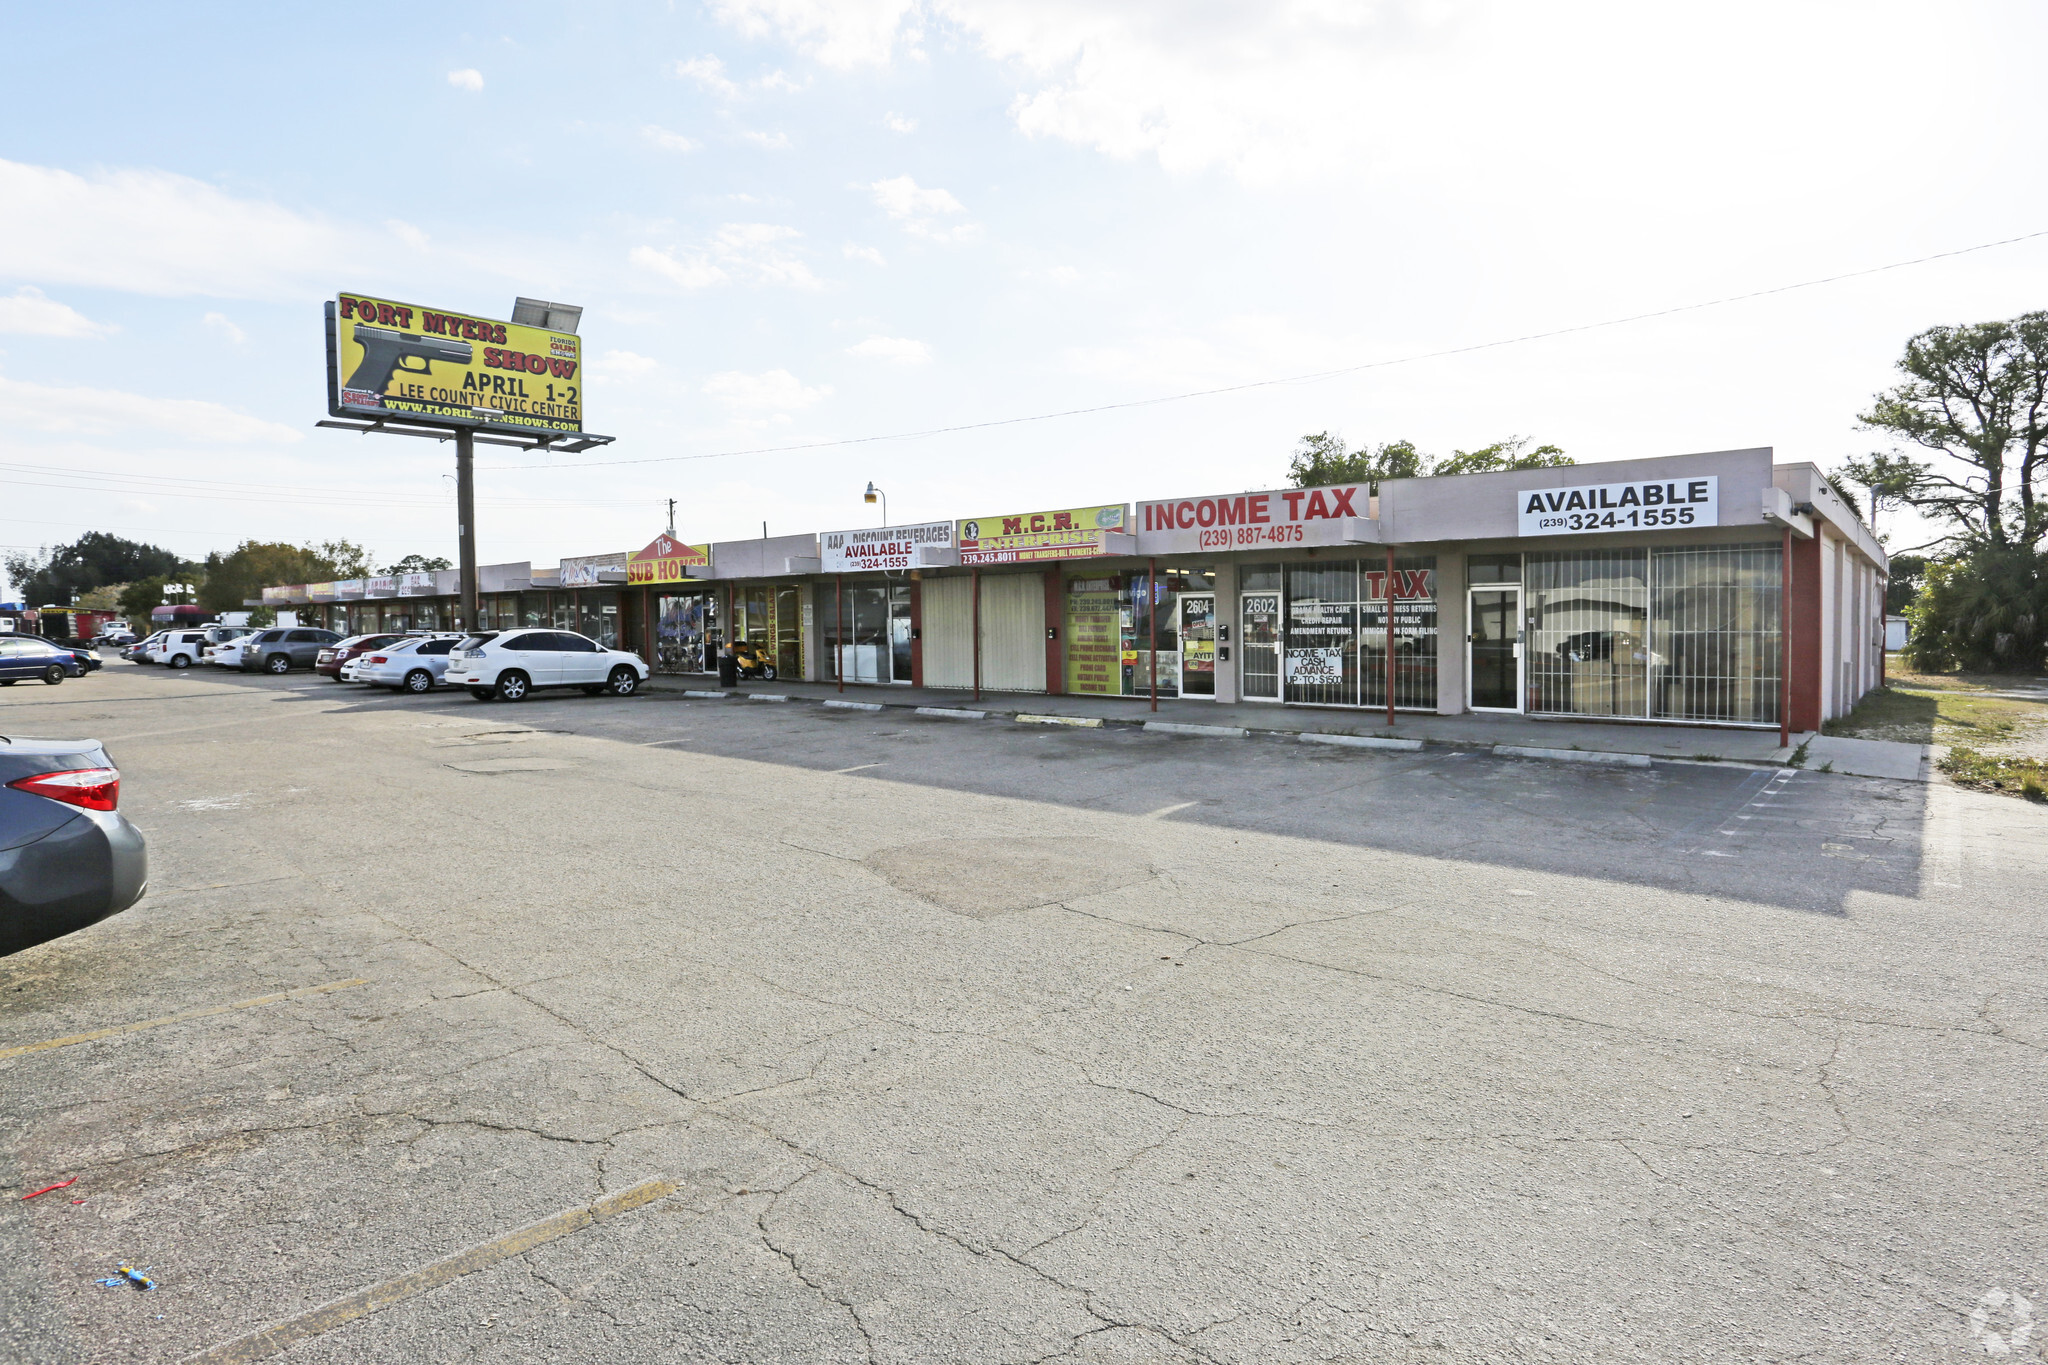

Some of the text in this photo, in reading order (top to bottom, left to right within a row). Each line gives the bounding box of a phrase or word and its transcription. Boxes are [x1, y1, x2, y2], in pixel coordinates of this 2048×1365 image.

[340, 297, 507, 345] FORT MYERS
[550, 336, 576, 346] FLORIDA
[550, 343, 576, 353] GUN
[550, 350, 576, 359] SHOWS
[483, 346, 578, 380] SHOW
[462, 371, 578, 405] APRIL 1-2
[400, 382, 578, 419] LEE COUNTY CIVIC CENTER
[1525, 480, 1708, 514] AVAILABLE
[1145, 487, 1358, 531] INCOME TAX
[1003, 512, 1079, 536] M.C.R.
[1199, 524, 1303, 550] (239) 887-4875
[656, 537, 672, 557] The
[845, 541, 912, 558] AVAILABLE
[963, 551, 1016, 564] 239.245.8011
[629, 561, 653, 582] SUB
[1365, 569, 1431, 600] TAX
[1186, 600, 1209, 614] 2604
[1246, 599, 1275, 613] 2602
[1335, 605, 1350, 613] CARE
[1362, 605, 1381, 613] SMALL
[1411, 605, 1437, 613] RETURNS
[1322, 616, 1343, 624] REPAIR
[1377, 616, 1421, 624] NOTRY PUBLIC
[1290, 627, 1352, 635] AMENDMENT RETURNS
[1401, 627, 1418, 635] FORM
[1286, 648, 1341, 658] NCOME TAX
[1301, 658, 1325, 667] CASH
[1293, 666, 1334, 675] ADVANCE
